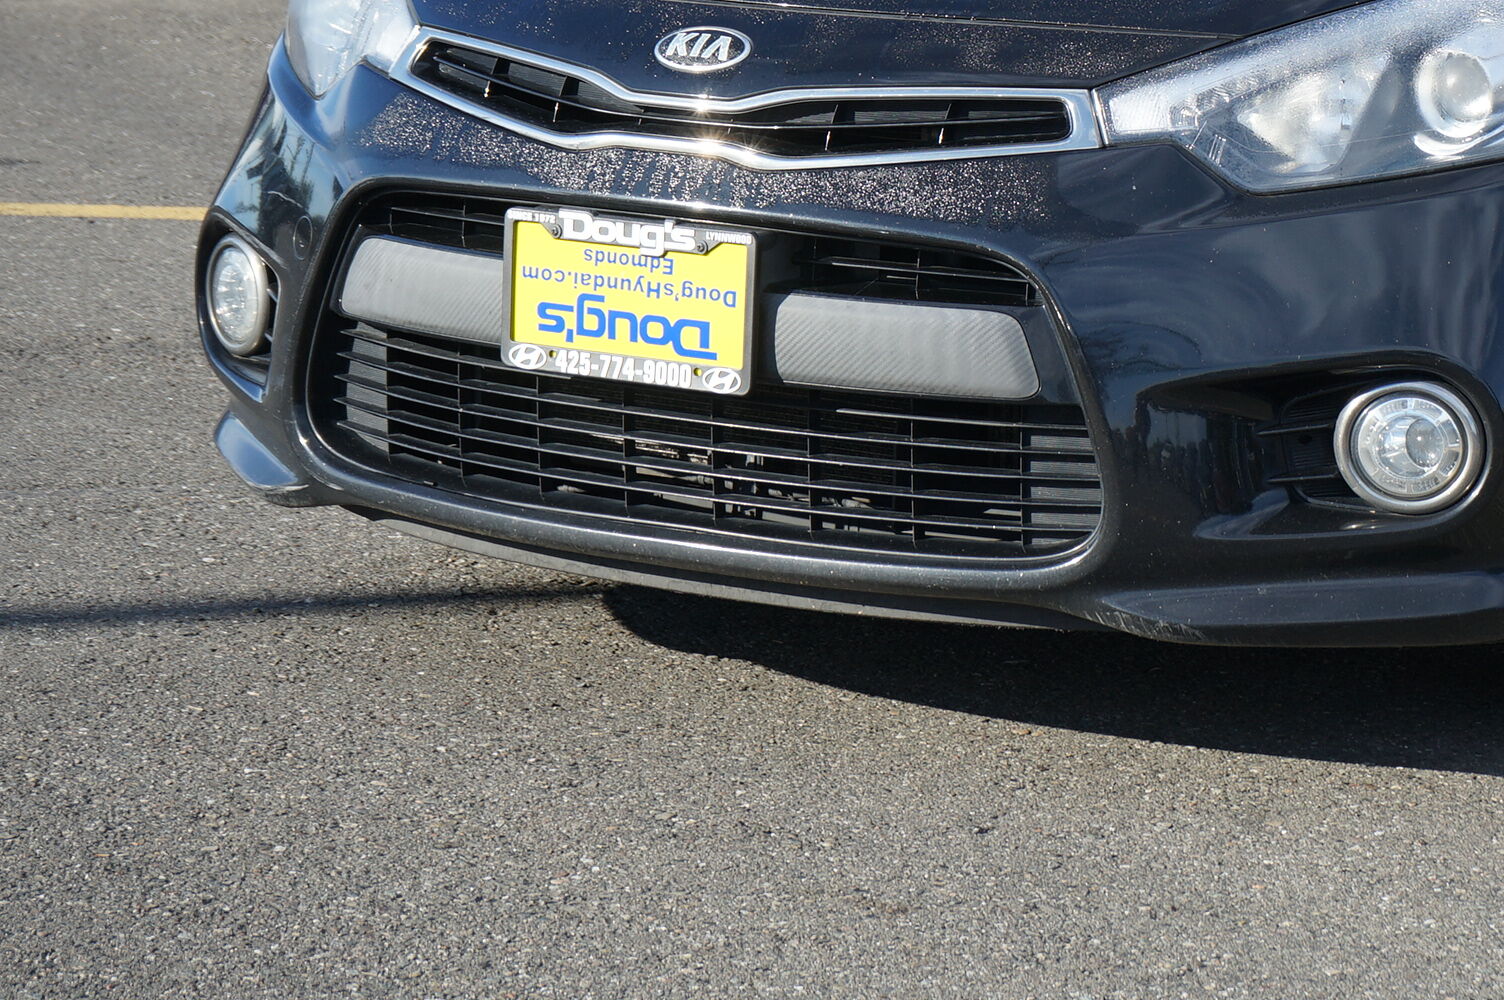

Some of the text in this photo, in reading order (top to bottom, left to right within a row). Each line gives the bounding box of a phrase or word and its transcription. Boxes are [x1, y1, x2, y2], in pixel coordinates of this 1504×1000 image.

[664, 32, 732, 62] KIA
[558, 208, 697, 257] Doug's
[705, 230, 753, 246] LYNNWOOD
[583, 248, 675, 276] Edmonds
[522, 265, 737, 308] Doug'sHyundai.com
[537, 293, 717, 361] Doug's
[553, 349, 693, 390] 425-774-9000
